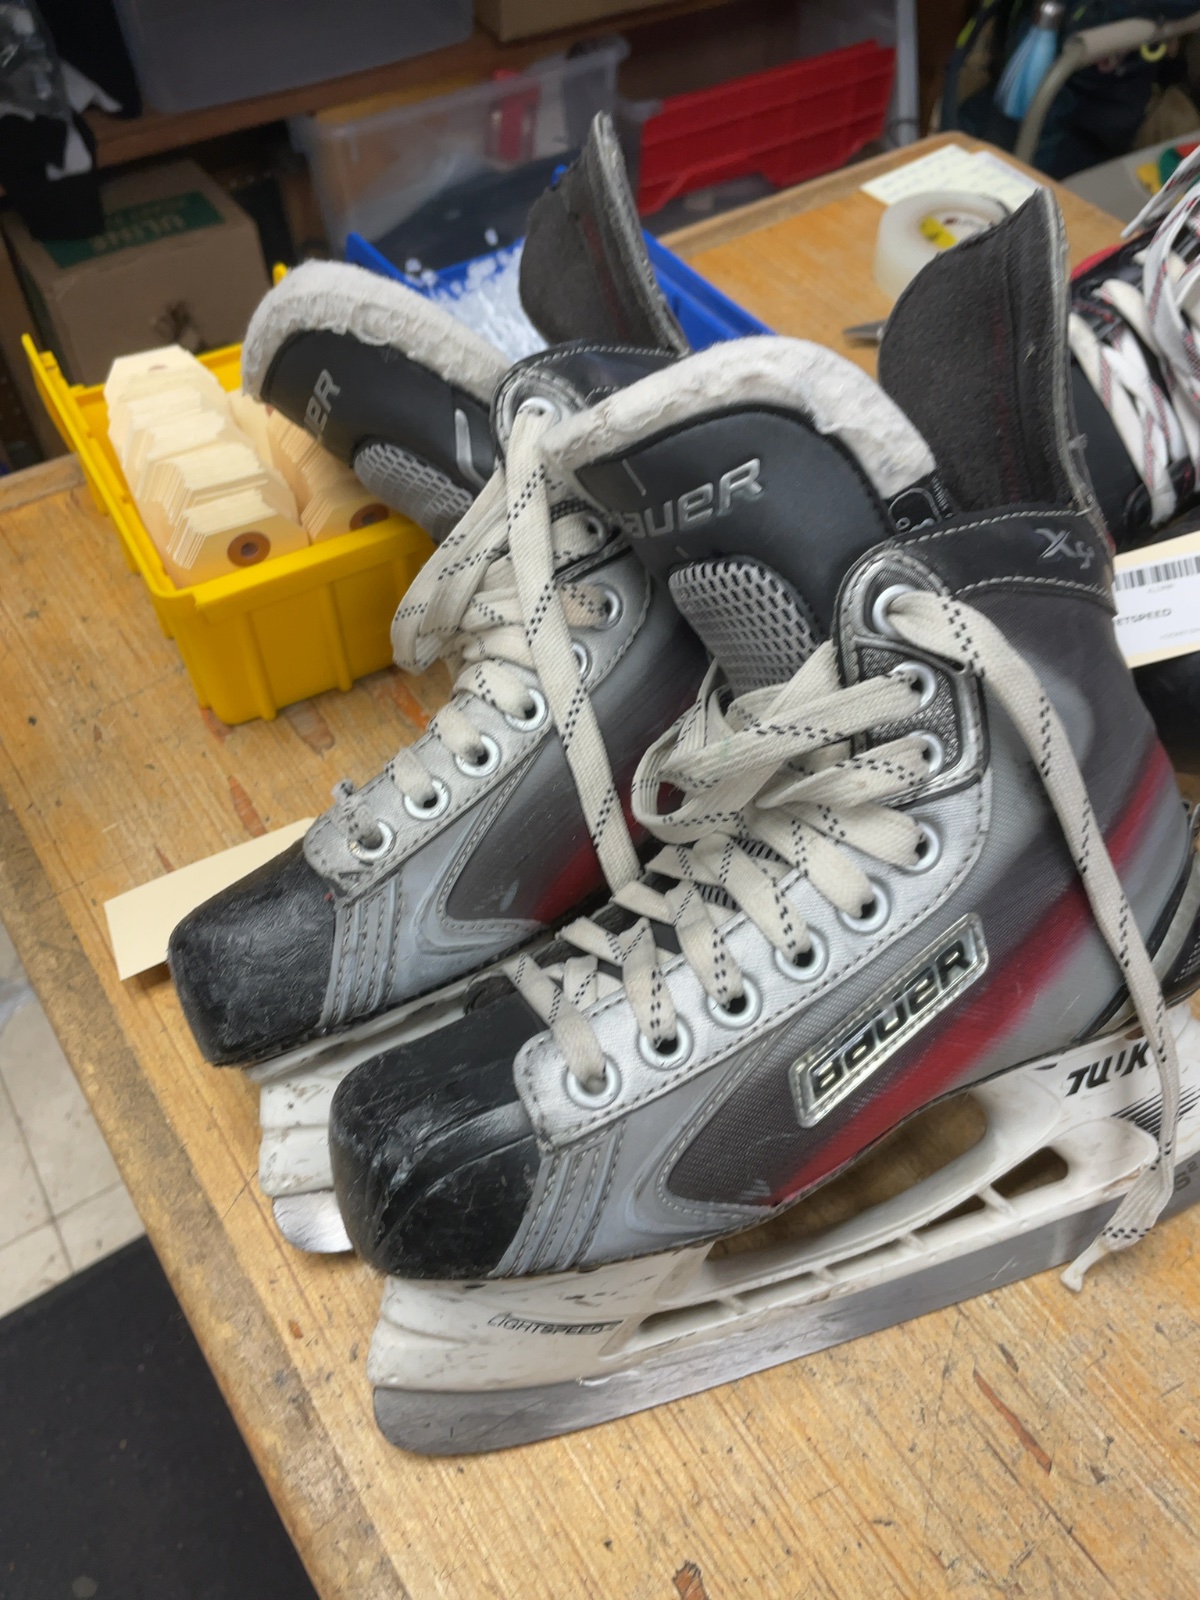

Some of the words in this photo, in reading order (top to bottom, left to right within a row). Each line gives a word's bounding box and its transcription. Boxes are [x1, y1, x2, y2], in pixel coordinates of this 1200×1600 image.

[304, 368, 341, 438] ER
[607, 457, 763, 540] AUER
[1115, 607, 1172, 627] ETSPEED
